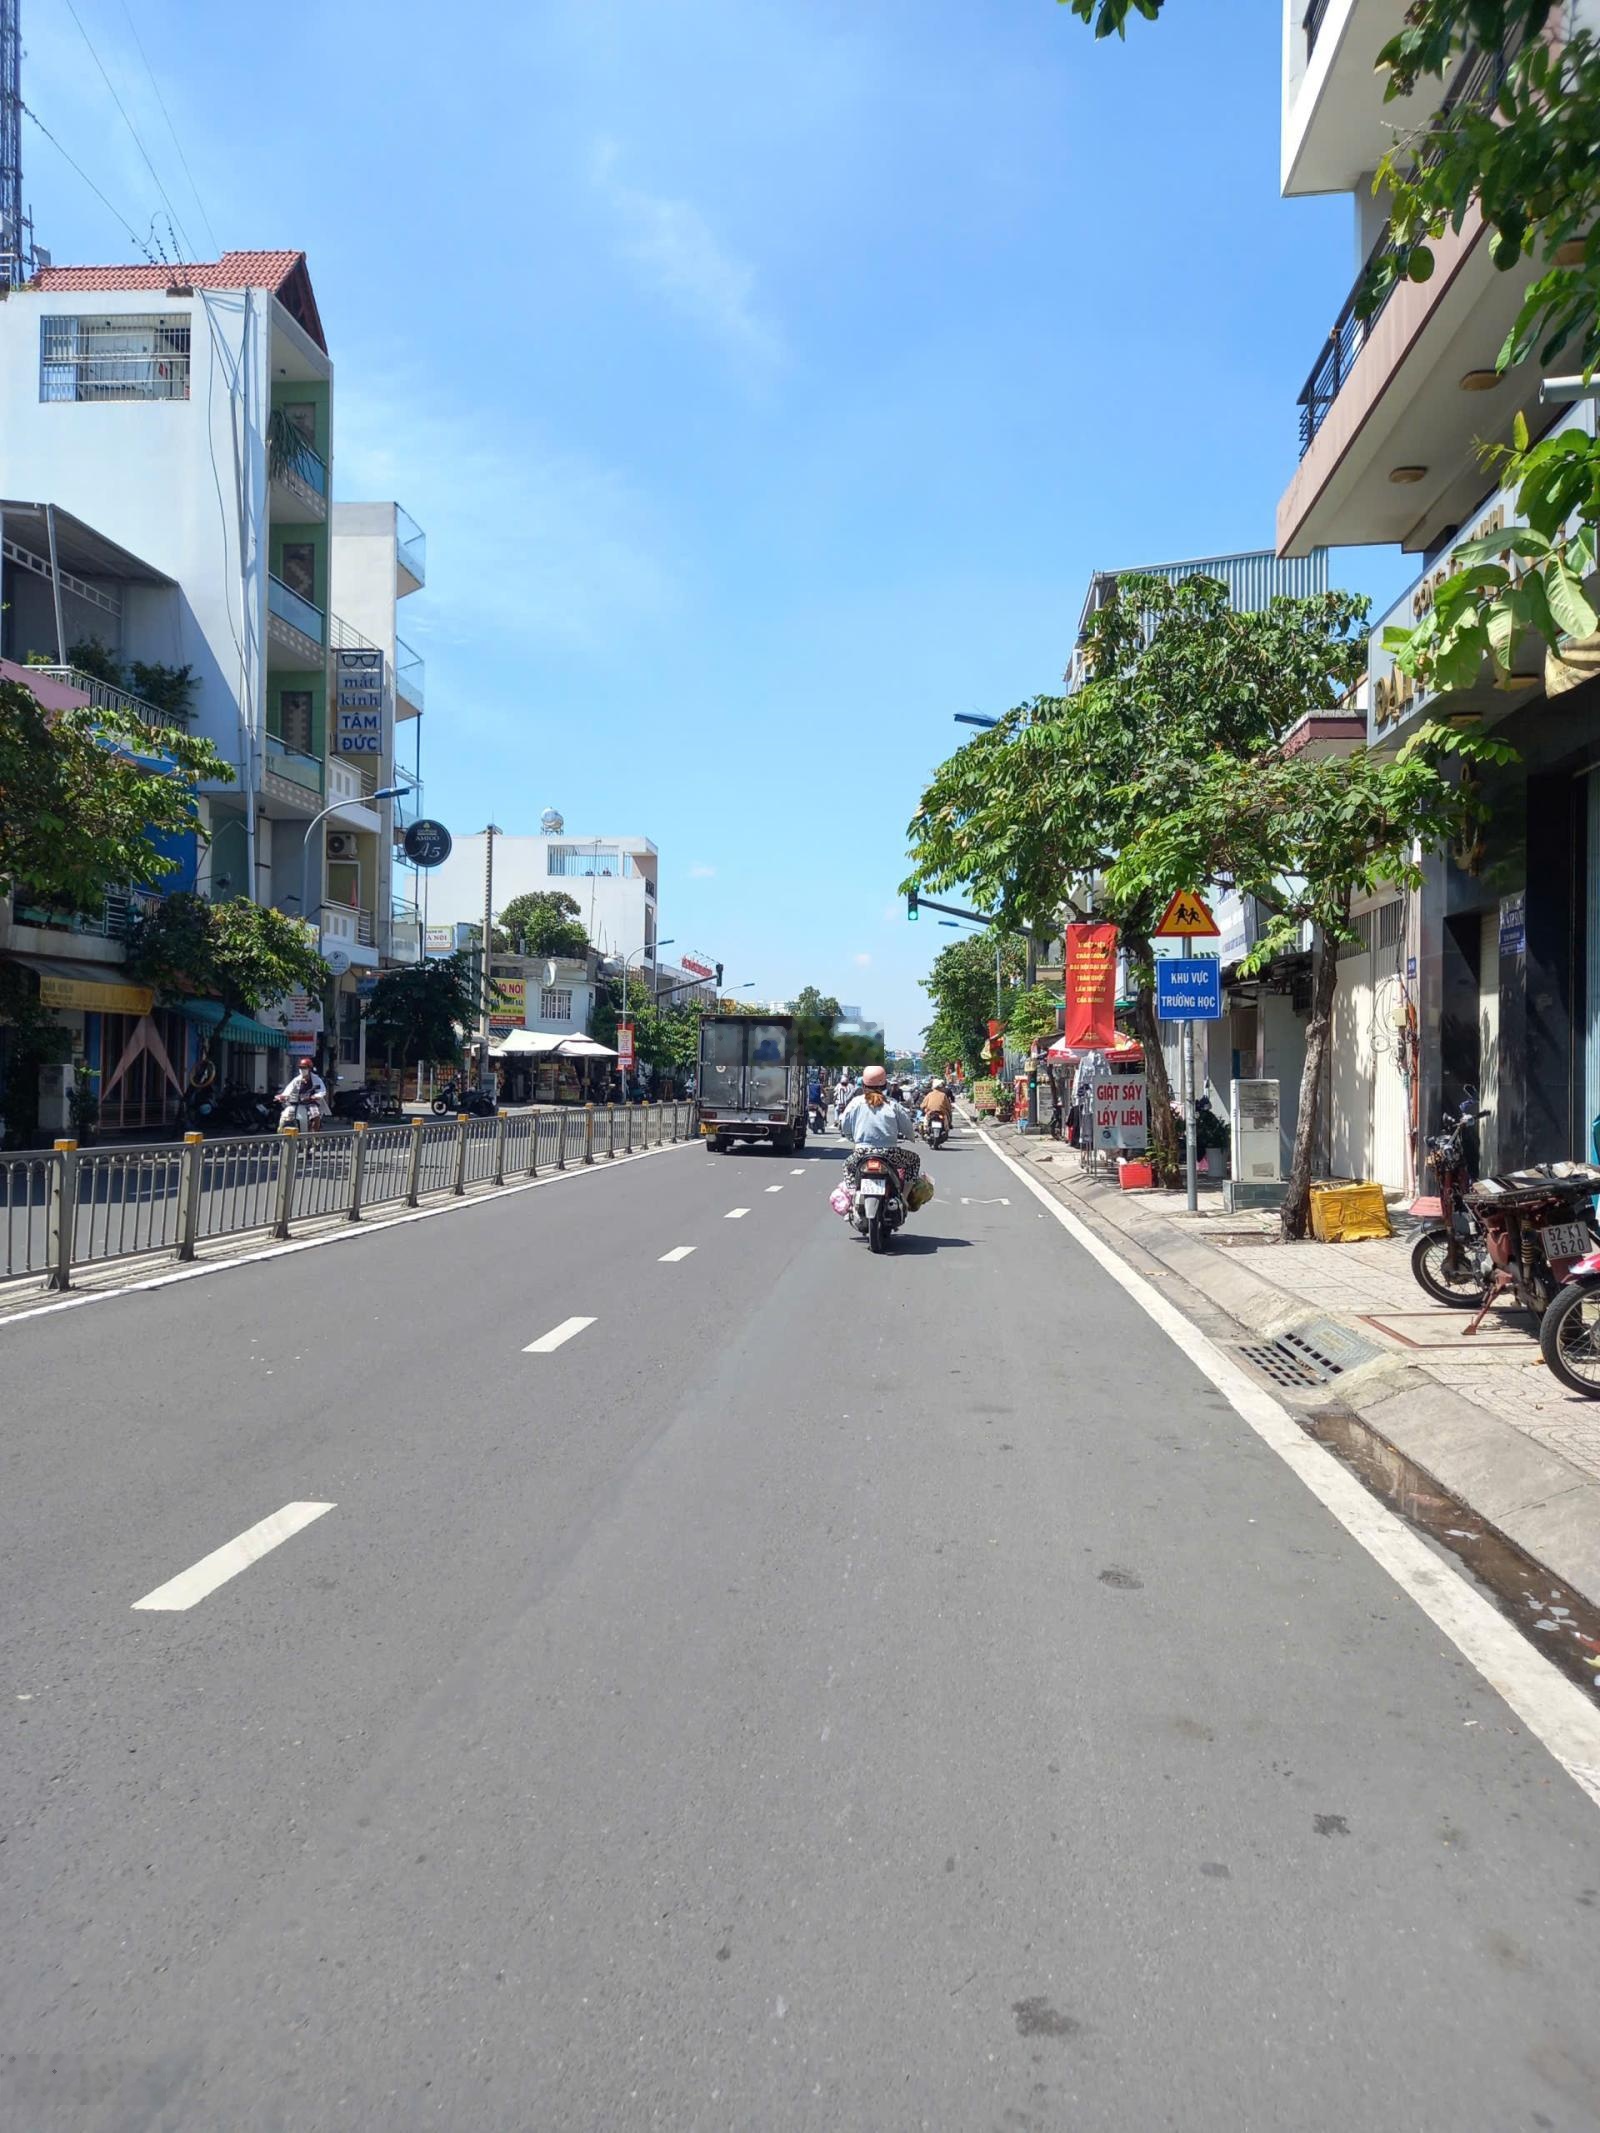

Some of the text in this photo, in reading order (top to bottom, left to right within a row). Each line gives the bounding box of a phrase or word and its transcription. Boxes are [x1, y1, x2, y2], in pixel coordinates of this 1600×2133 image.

[342, 712, 377, 729] TÂM
[342, 734, 377, 750] ĐỨC
[1171, 970, 1209, 986] KHU VỰC
[1161, 992, 1216, 1010] TRƯỜNG HỌC
[1552, 1239, 1585, 1256] 3620
